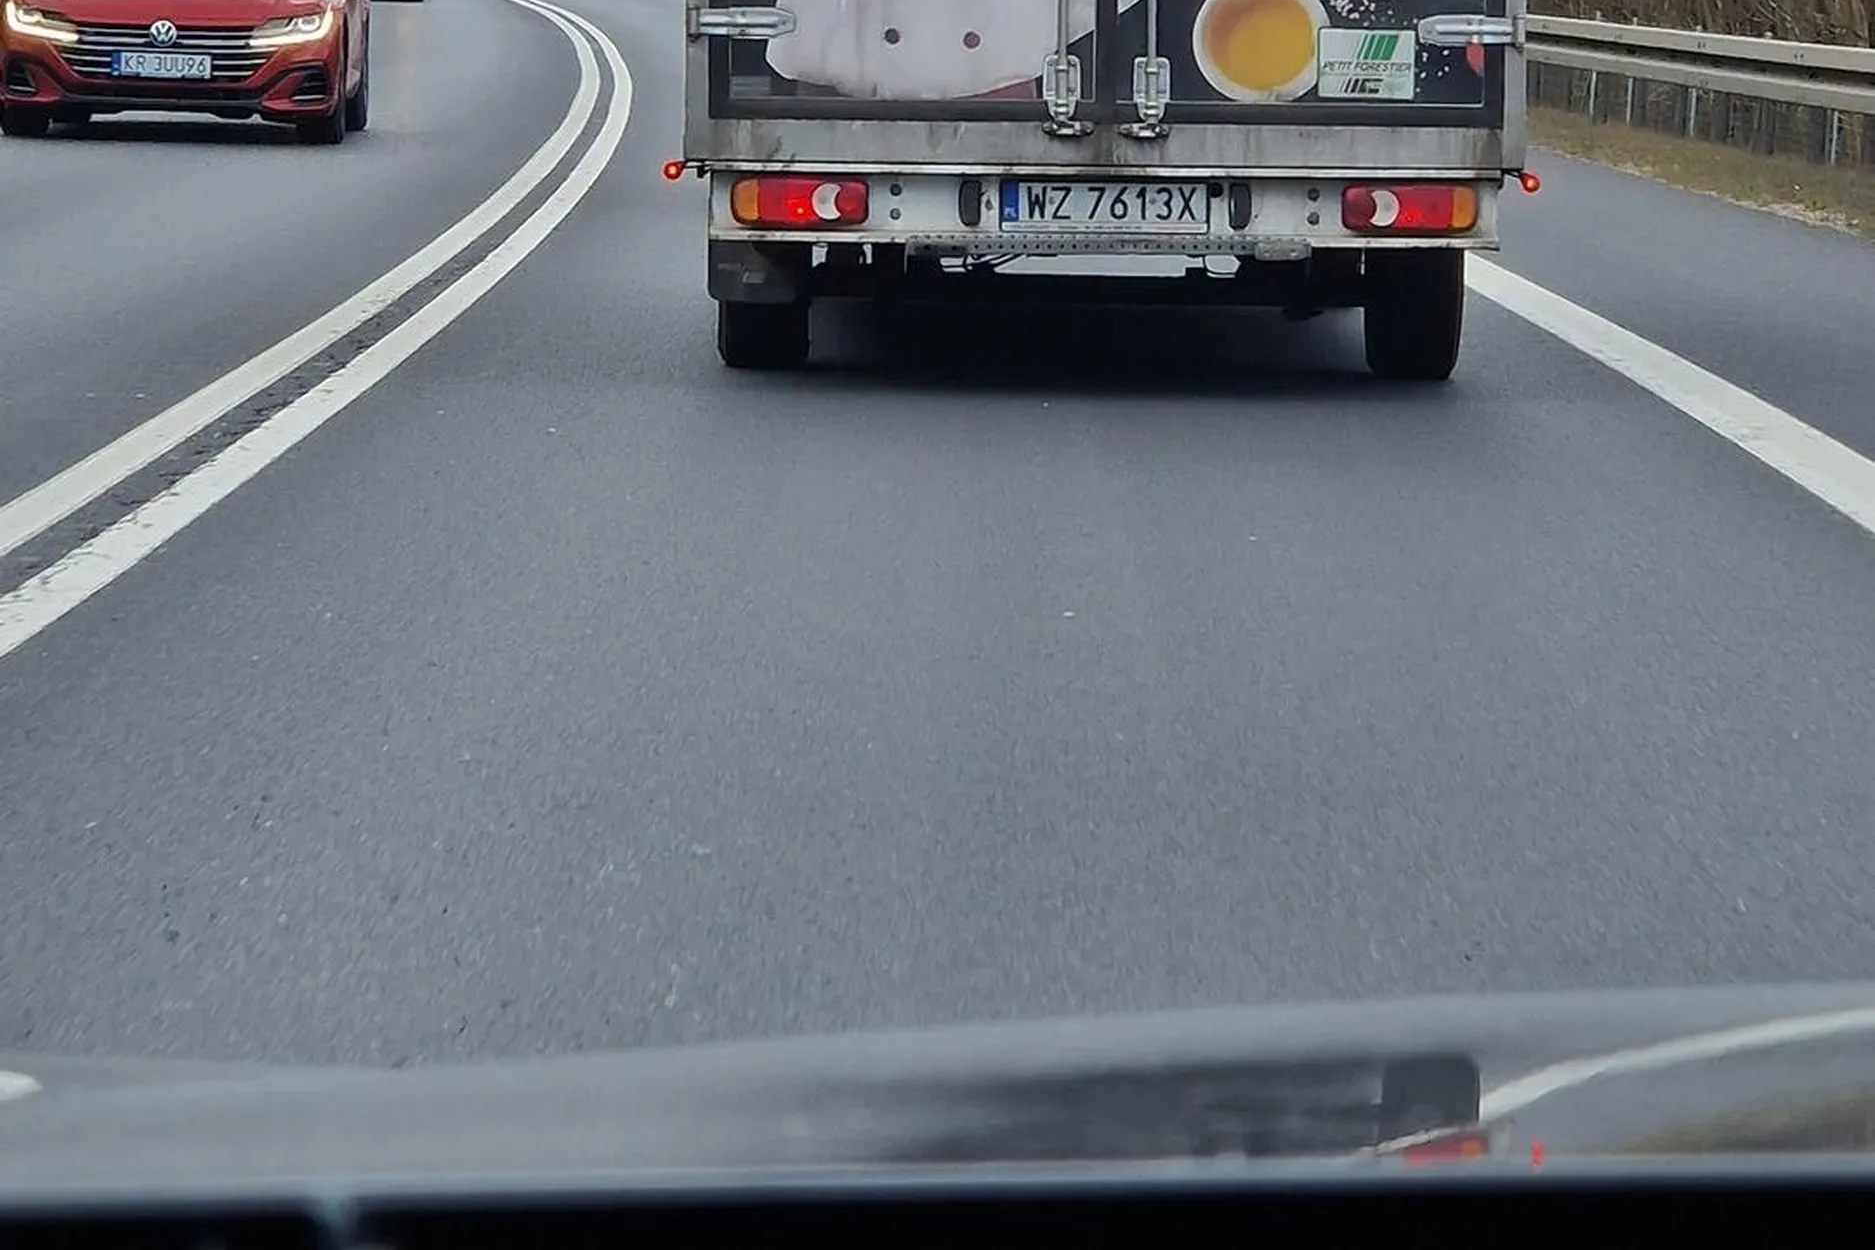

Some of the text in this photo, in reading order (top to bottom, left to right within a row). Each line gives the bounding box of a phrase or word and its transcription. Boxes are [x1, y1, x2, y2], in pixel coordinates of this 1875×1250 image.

[123, 55, 147, 71] KR
[1026, 186, 1197, 221] WZ 7613X
